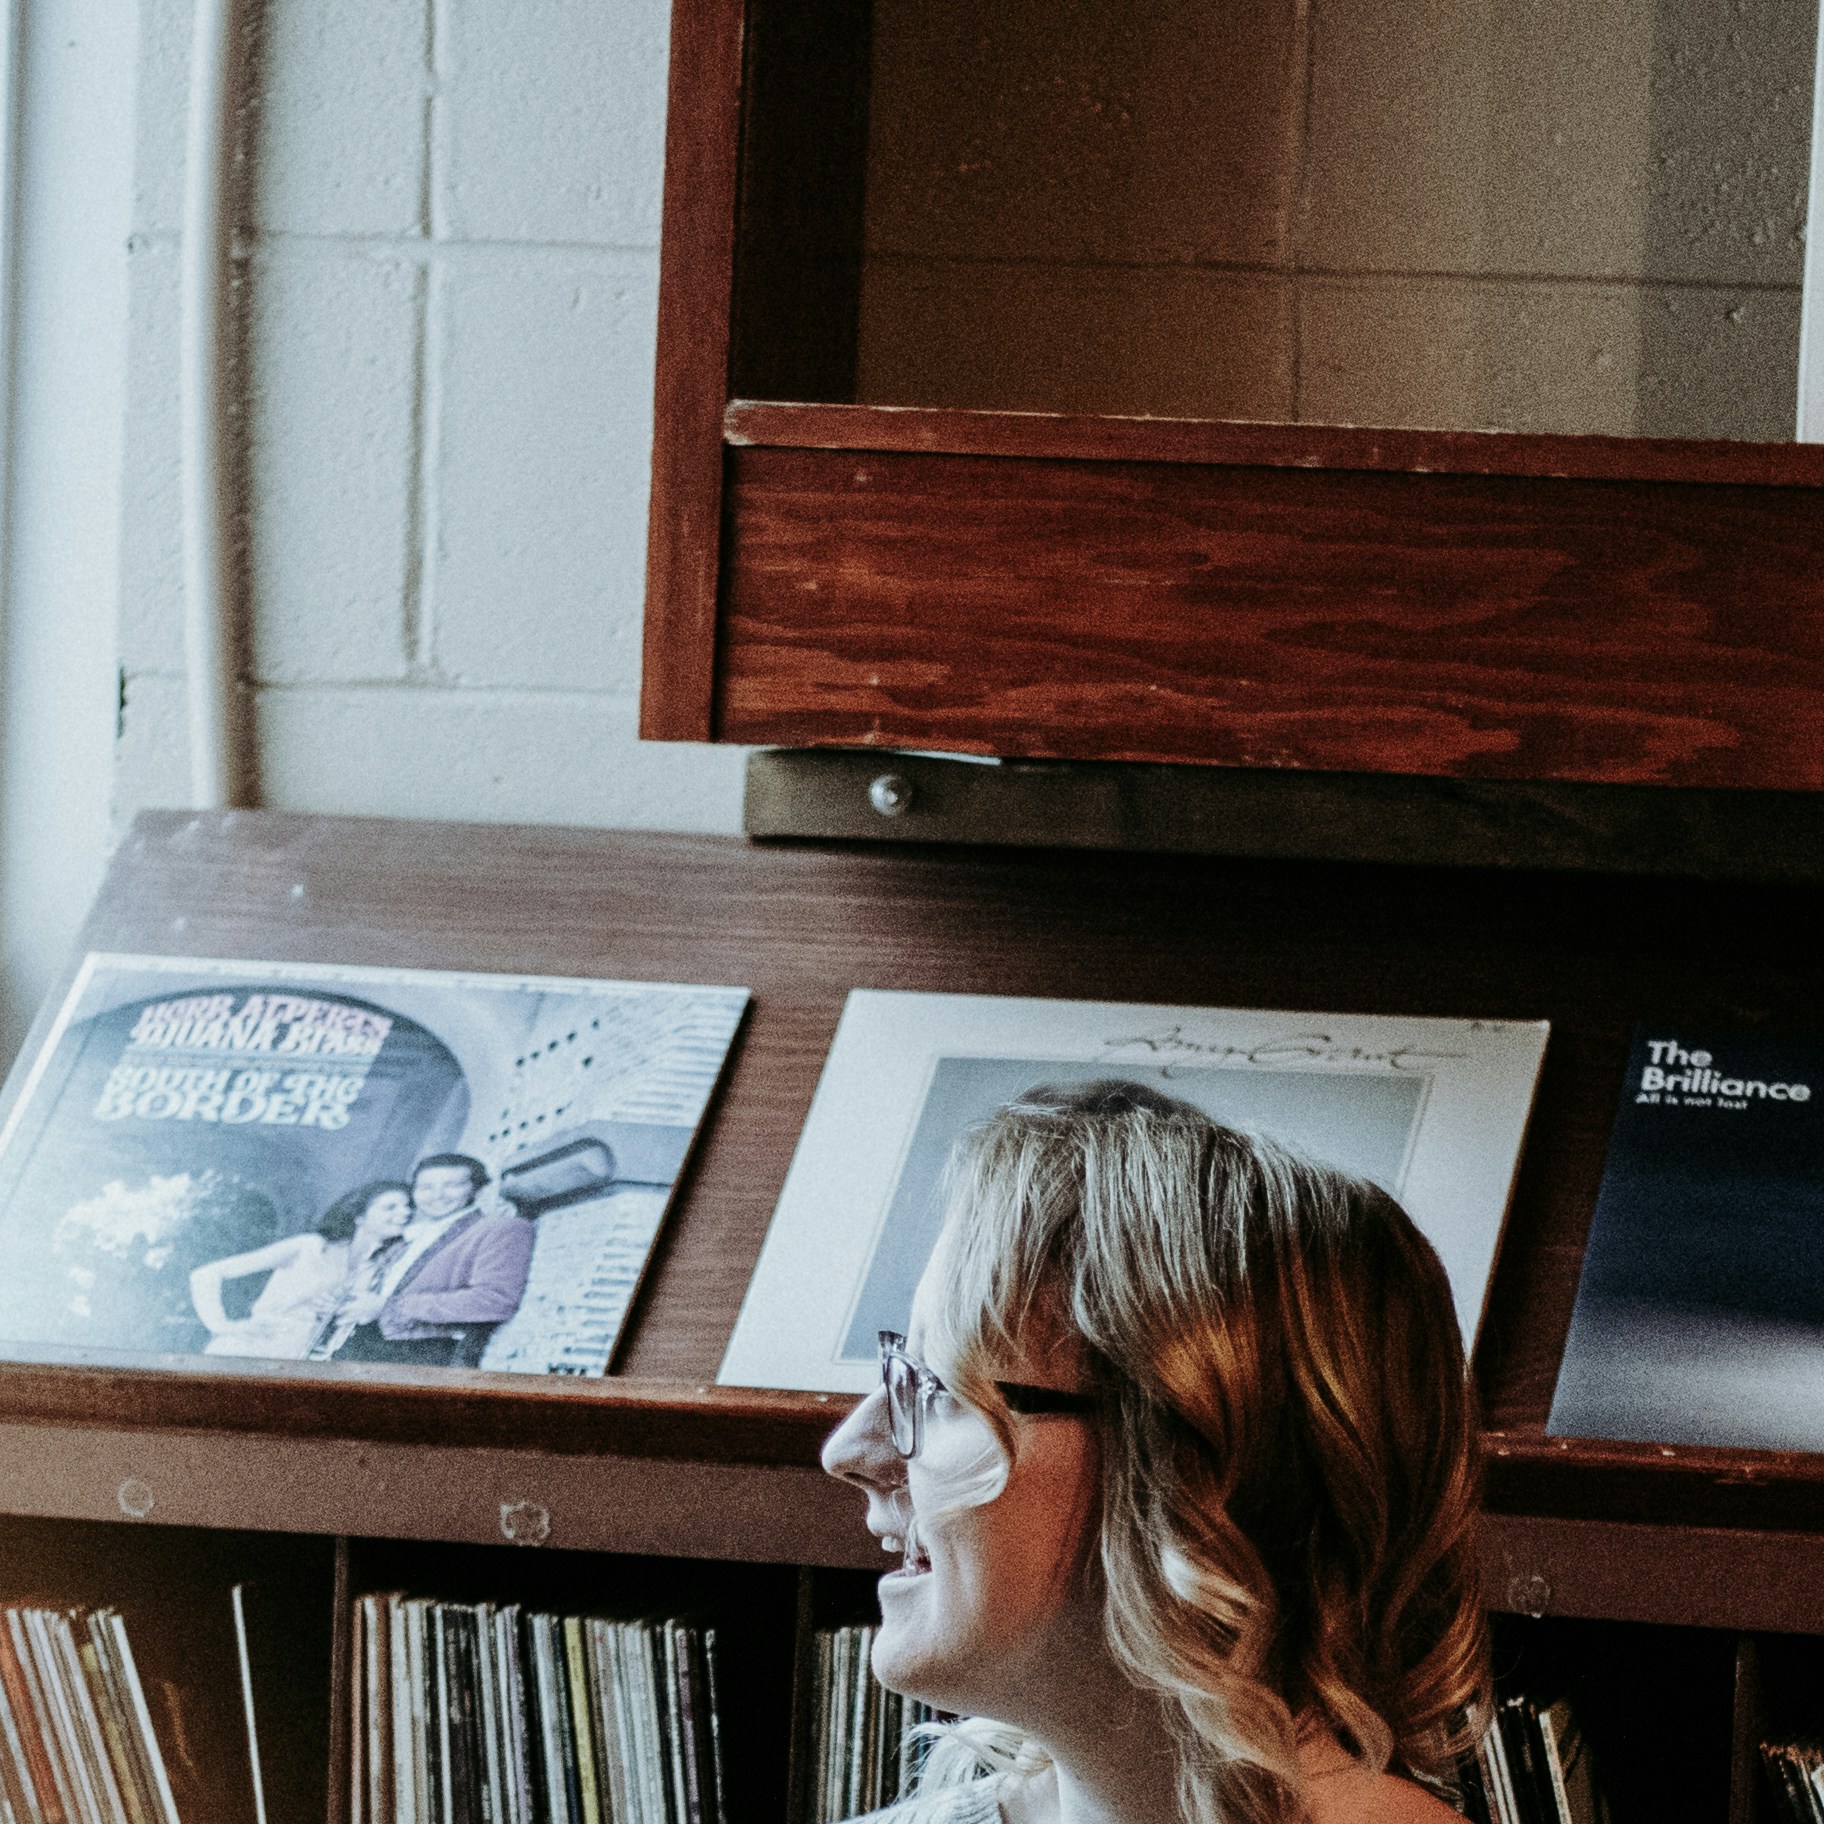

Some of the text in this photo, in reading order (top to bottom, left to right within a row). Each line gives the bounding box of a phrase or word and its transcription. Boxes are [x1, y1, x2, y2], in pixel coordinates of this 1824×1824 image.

[1648, 1039, 1713, 1067] The
[107, 1064, 366, 1104] SOUTH OF THE
[1641, 1066, 1812, 1101] Brilliance
[93, 1089, 351, 1130] BORDER
